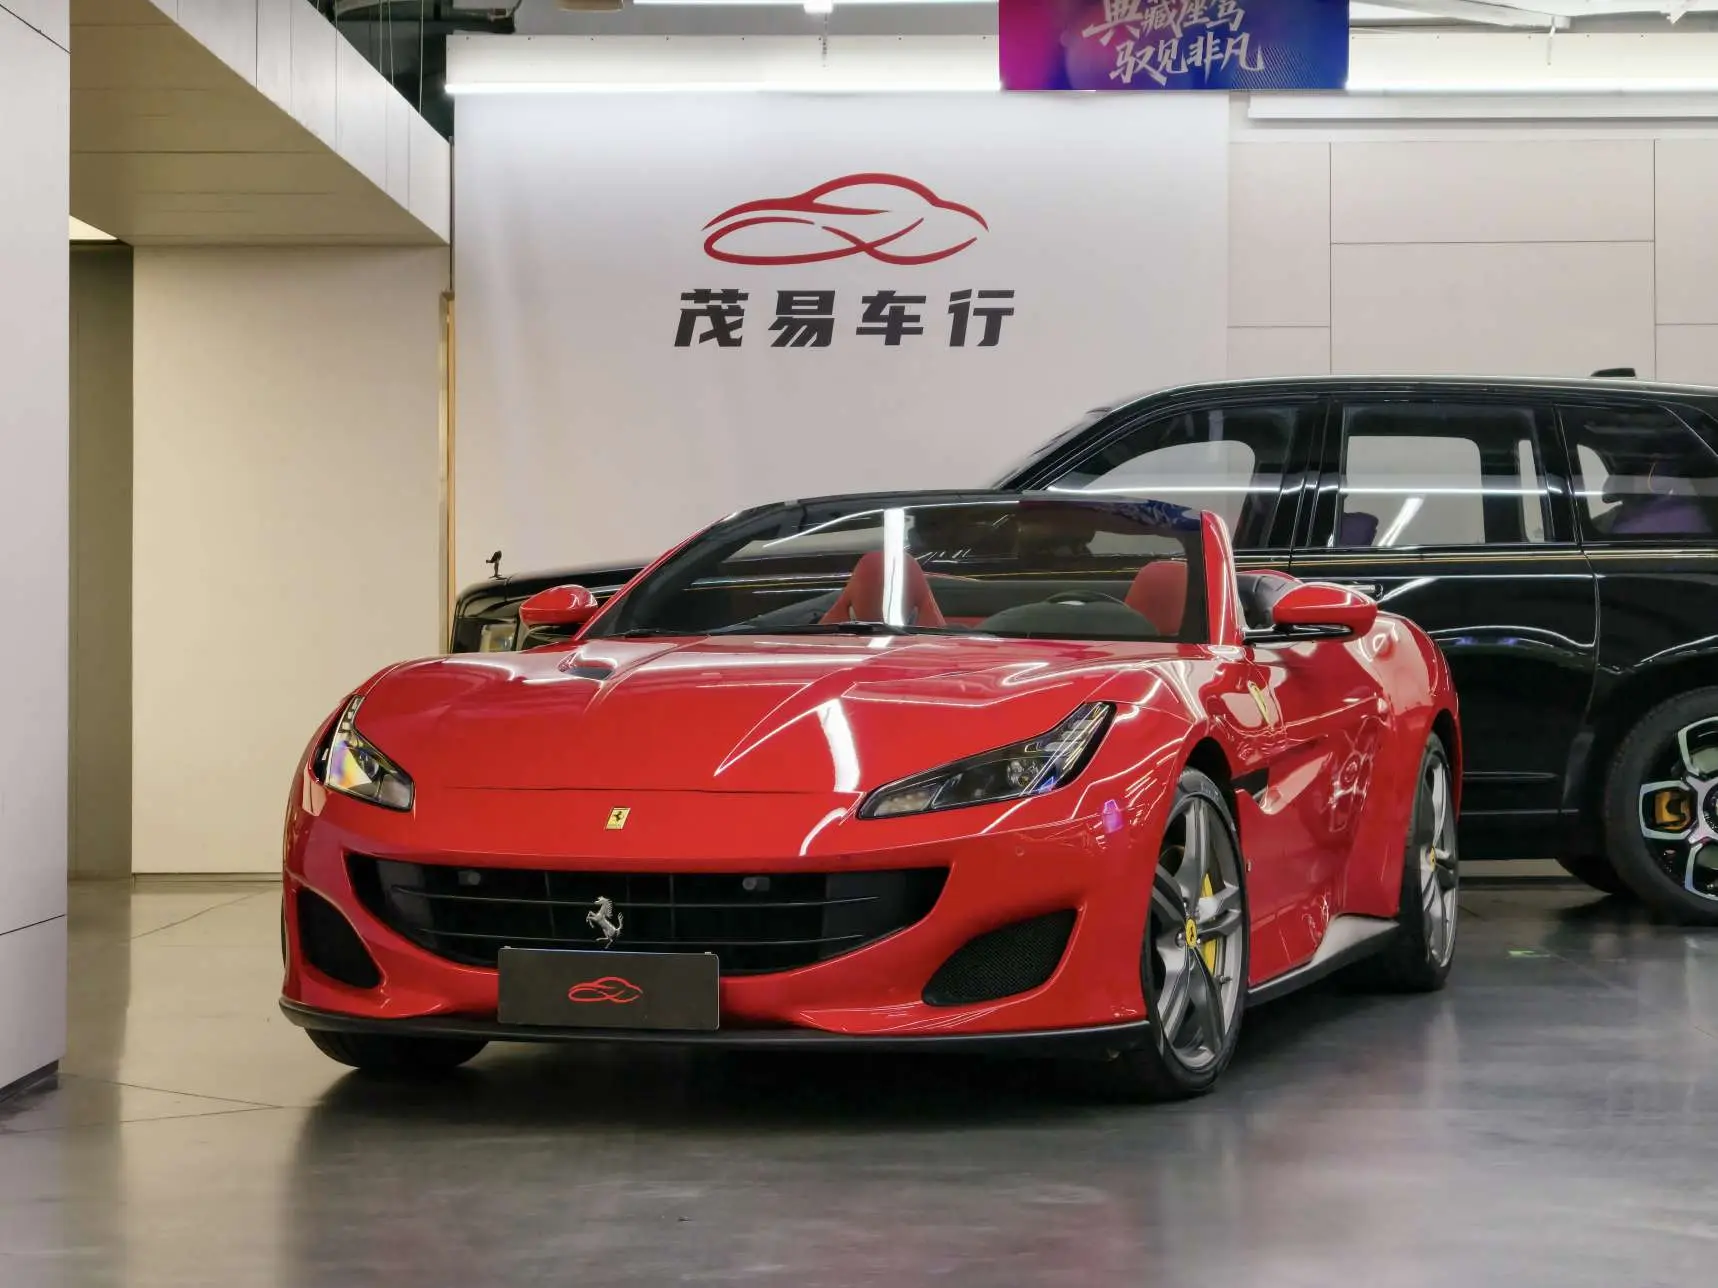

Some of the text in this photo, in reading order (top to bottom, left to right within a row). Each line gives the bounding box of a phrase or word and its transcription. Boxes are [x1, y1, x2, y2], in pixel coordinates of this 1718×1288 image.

[1109, 31, 1265, 86] 驭见非凡
[674, 288, 1015, 347] 茂易车行
